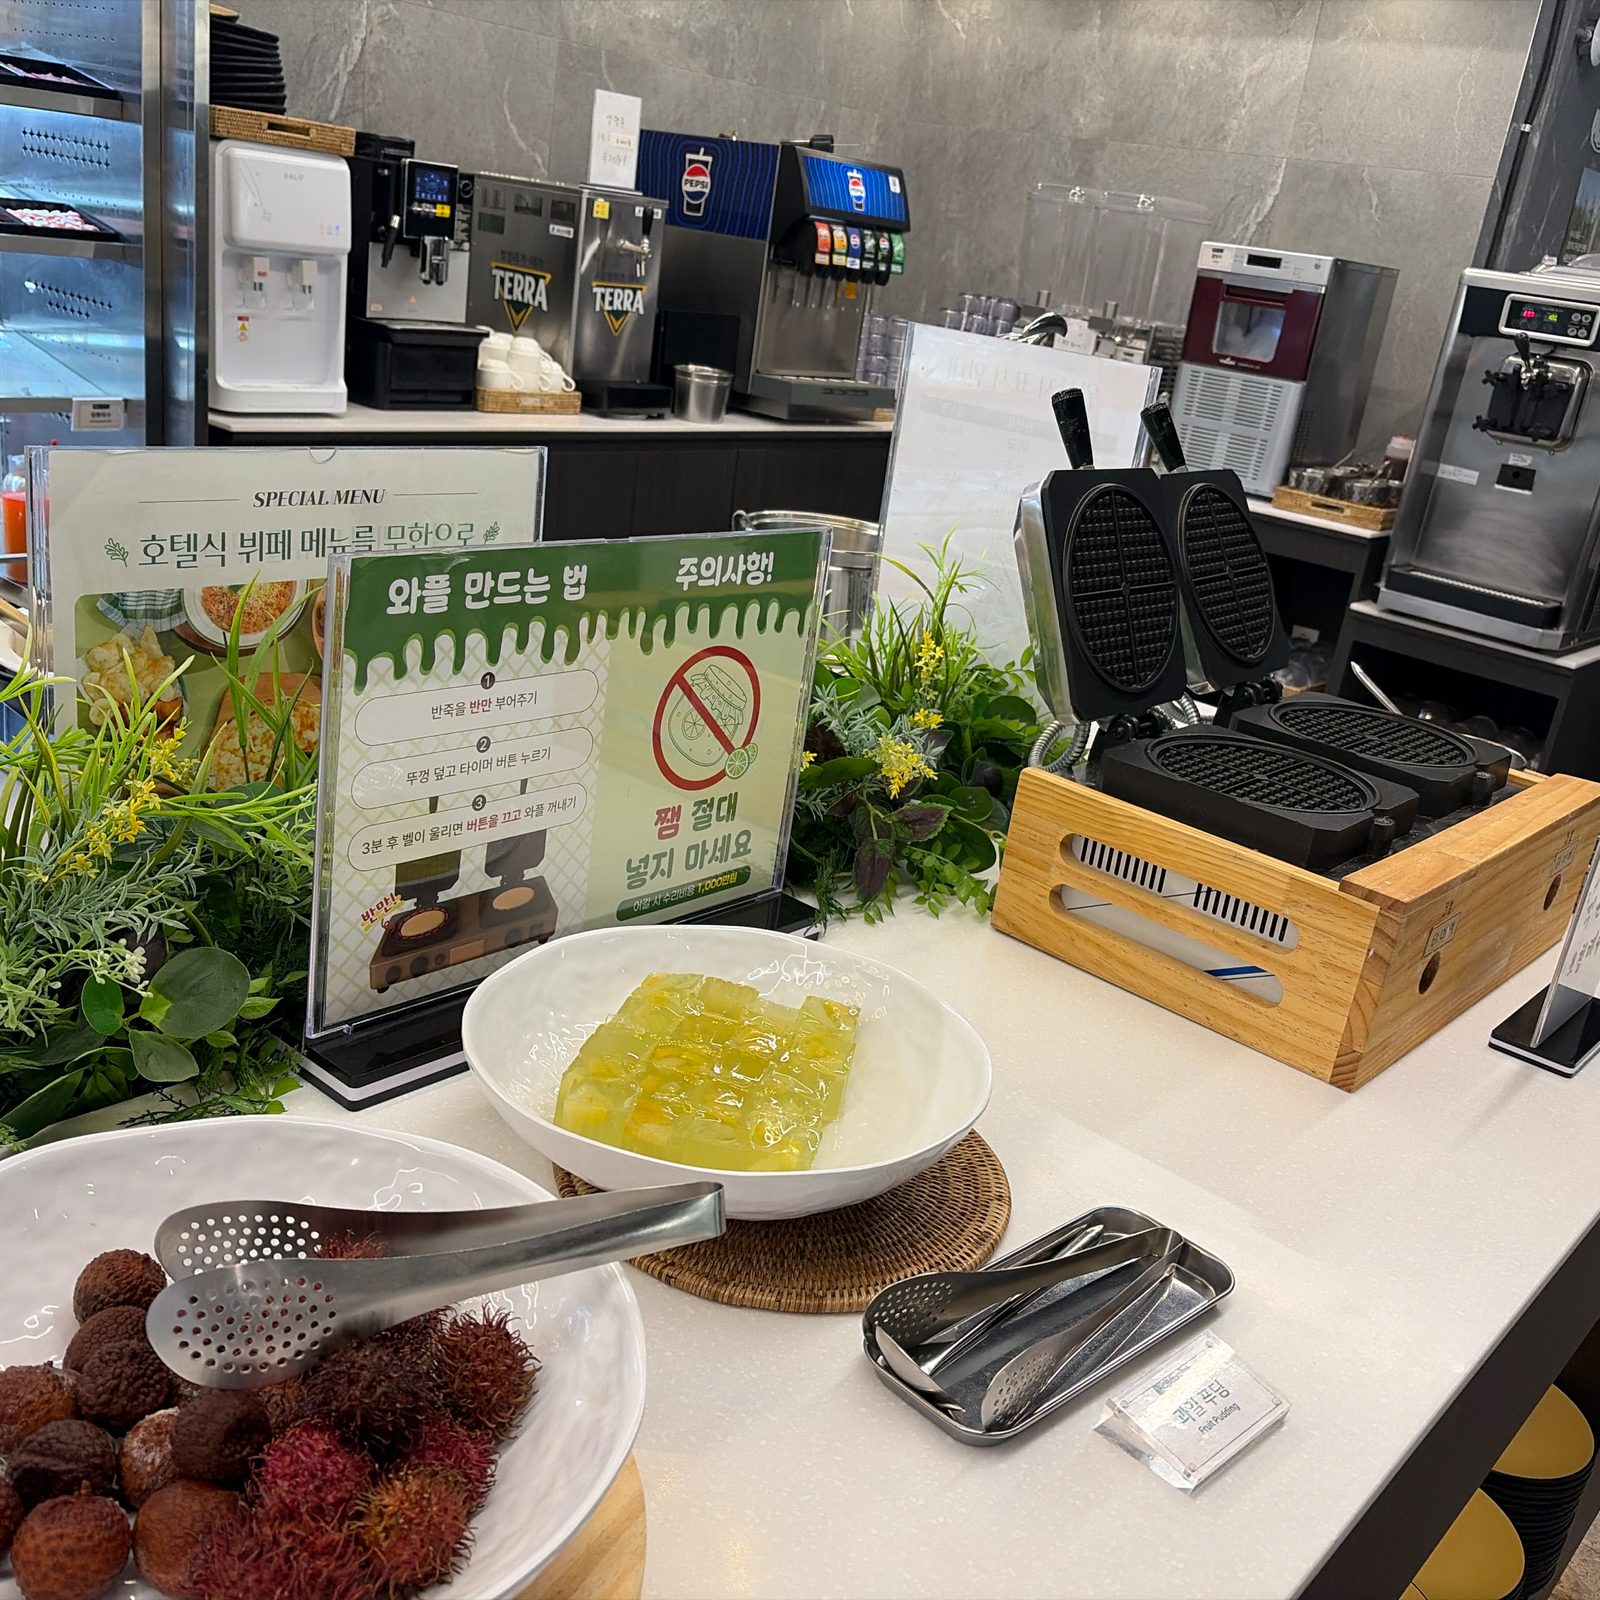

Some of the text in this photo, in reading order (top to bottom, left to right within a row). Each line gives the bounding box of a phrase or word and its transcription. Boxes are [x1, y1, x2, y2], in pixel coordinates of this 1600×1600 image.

[684, 178, 708, 189] PEPSI
[491, 269, 548, 312] TERRA
[592, 286, 645, 315] TERRA
[252, 489, 386, 508] SPECIAL MENU
[138, 531, 226, 569] 호텔식
[238, 529, 292, 564] 뷔페
[386, 564, 588, 615] 와플 만드는 법
[675, 551, 775, 591] 주의사항!
[431, 690, 538, 720] 반죽을 반만 부어주기
[405, 746, 551, 786] 뚜껑 덮고 타이머 버튼 누르기
[361, 795, 577, 855] 3분 후 벨이 울리면 버튼을 끄고 와플 꺼내기
[654, 791, 738, 841] 쨈 절대
[625, 829, 752, 890] 넣지 마세요
[360, 891, 397, 924] 반만!
[633, 871, 738, 912] 어길 시 수리비용 1,000만원
[1172, 1396, 1208, 1424] 과일
[1197, 1379, 1230, 1406] 푸딩
[1198, 1402, 1241, 1435] Fruit Pudding
